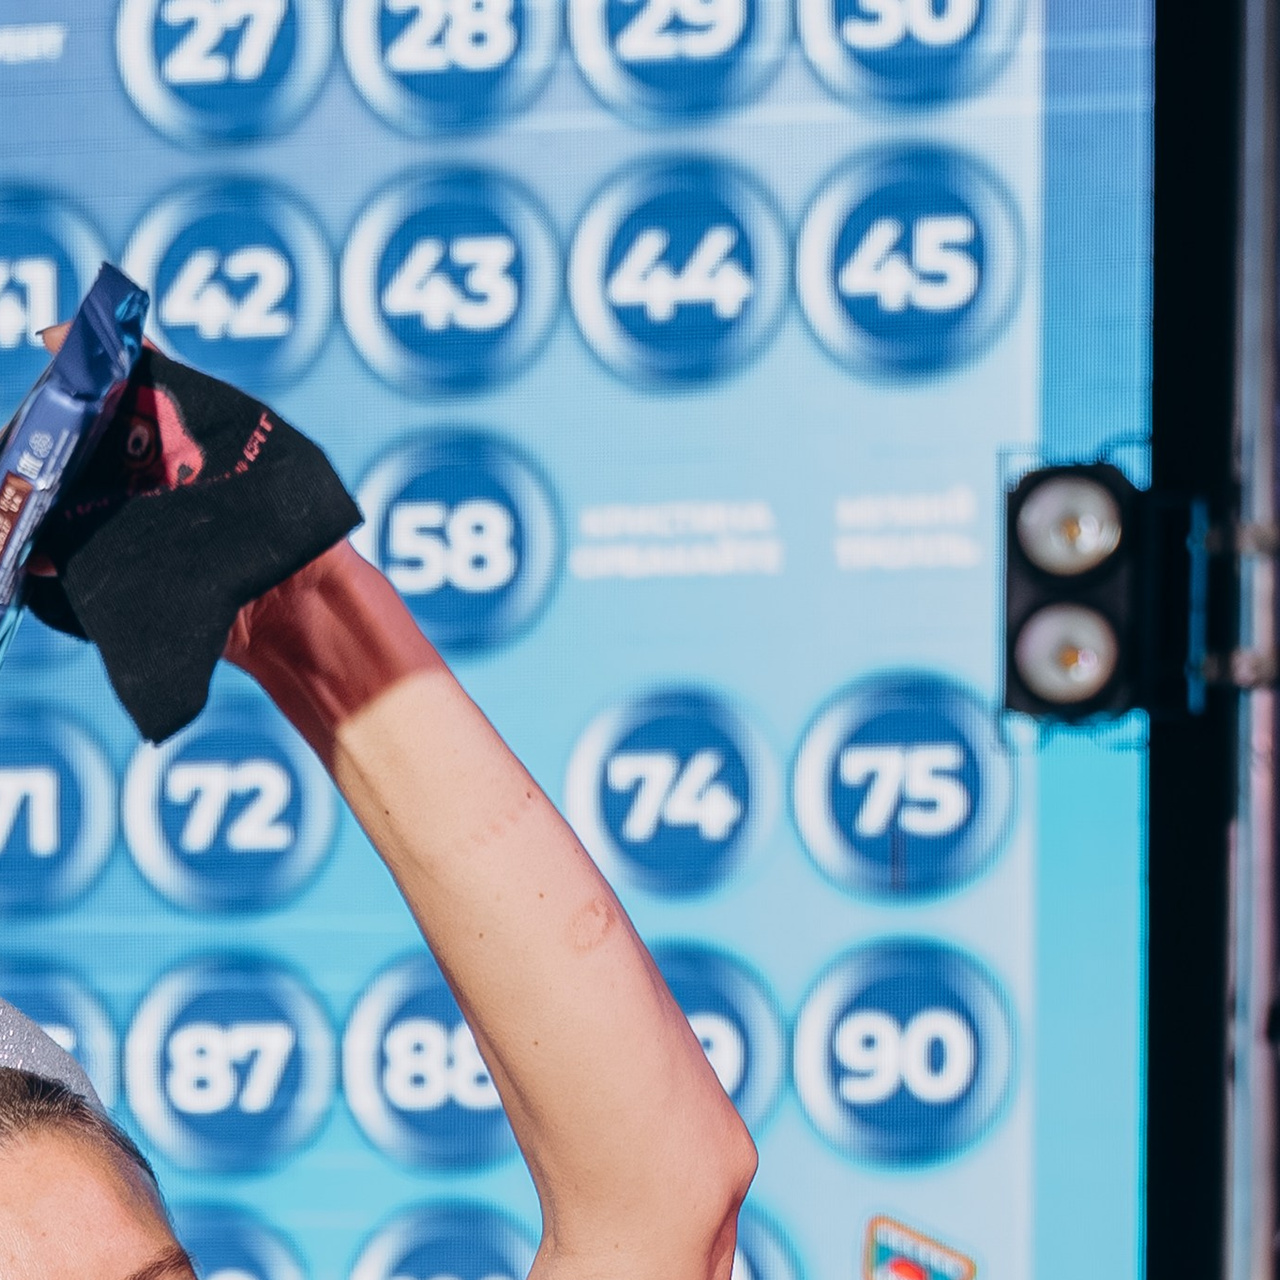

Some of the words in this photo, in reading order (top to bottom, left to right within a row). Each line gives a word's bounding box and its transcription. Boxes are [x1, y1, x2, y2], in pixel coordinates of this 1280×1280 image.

[163, 0, 286, 83] 27
[386, 0, 516, 72] 28
[616, 0, 746, 61] 29
[160, 248, 291, 338] 42
[383, 238, 516, 329] 43
[609, 226, 754, 321] 44
[839, 217, 977, 310] 45
[386, 502, 515, 594] 58
[167, 761, 291, 850] 72
[608, 753, 739, 840] 74
[840, 745, 967, 835] 75
[168, 1024, 294, 1113] 87
[834, 1010, 973, 1103] 90
